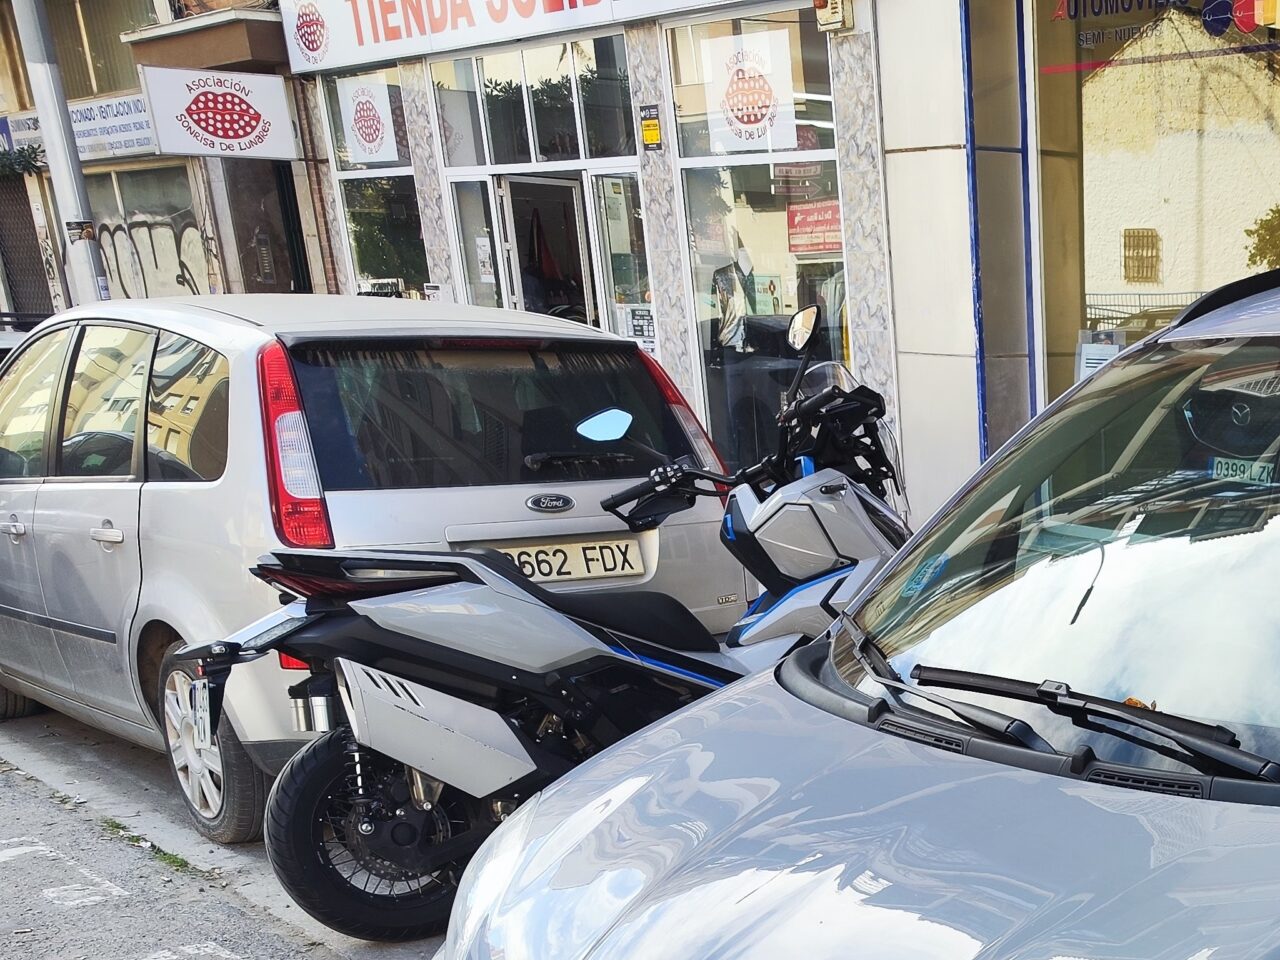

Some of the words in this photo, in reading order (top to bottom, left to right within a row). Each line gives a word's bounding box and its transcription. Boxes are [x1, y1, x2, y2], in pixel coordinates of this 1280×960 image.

[1078, 30, 1104, 46] SEMI
[220, 142, 235, 152] De
[1216, 461, 1246, 478] 0399
[539, 496, 564, 508] Ford
[503, 548, 571, 579] 662
[582, 544, 634, 574] FDX
